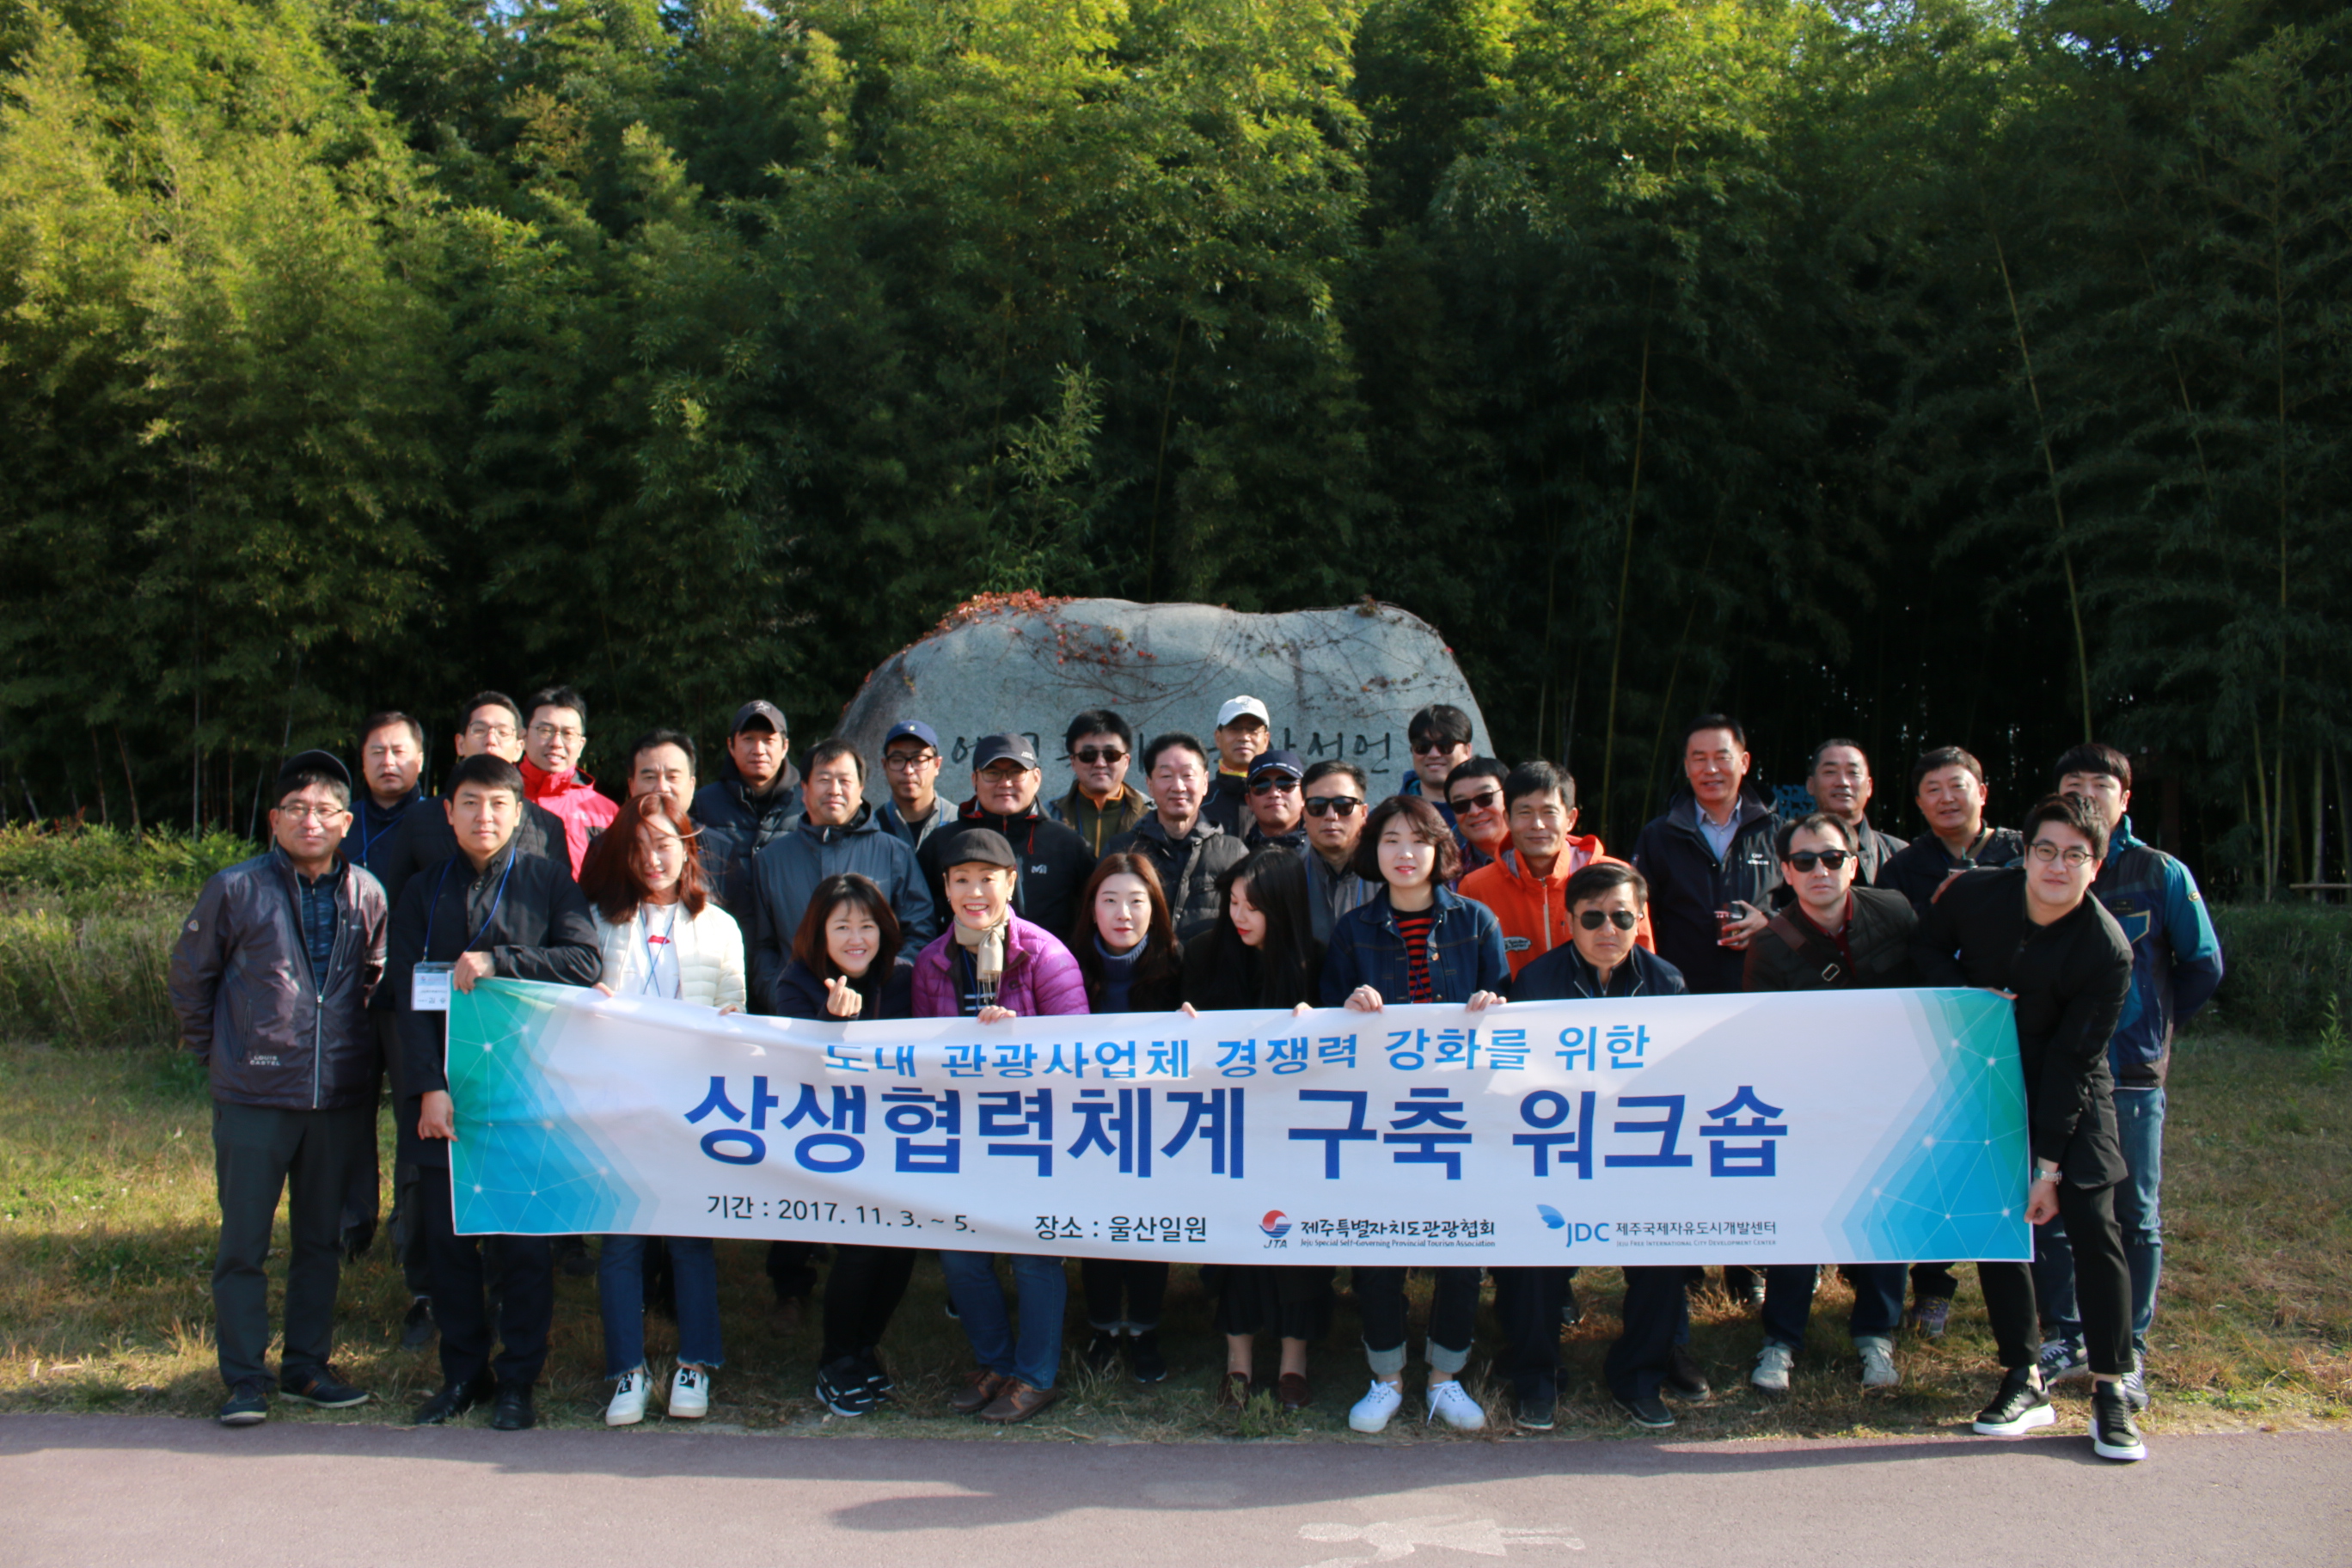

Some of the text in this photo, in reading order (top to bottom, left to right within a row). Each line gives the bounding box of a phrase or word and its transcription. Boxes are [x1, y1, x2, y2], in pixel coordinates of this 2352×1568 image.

[824, 1023, 1651, 1080] 도내 관광사업체 경쟁력 강화를 위한
[684, 1075, 1789, 1181] 상생협력체계 구축 워크숍
[707, 1195, 755, 1220] 기간
[778, 1198, 846, 1224] 2017.
[855, 1205, 891, 1227] 11.
[899, 1210, 922, 1229] 3.
[954, 1214, 977, 1234] 5.
[1034, 1215, 1083, 1240] 장소
[1107, 1216, 1207, 1243] 울산일원
[1301, 1218, 1496, 1240] 제주특별자치도관광협회
[1565, 1222, 1611, 1248] JDC
[1616, 1221, 1777, 1236] 제주국제자유도시개발센터
[1263, 1239, 1289, 1249] JTA
[1300, 1239, 1314, 1247] Jeju
[1314, 1239, 1338, 1248] Special
[1392, 1239, 1426, 1247] Provincial
